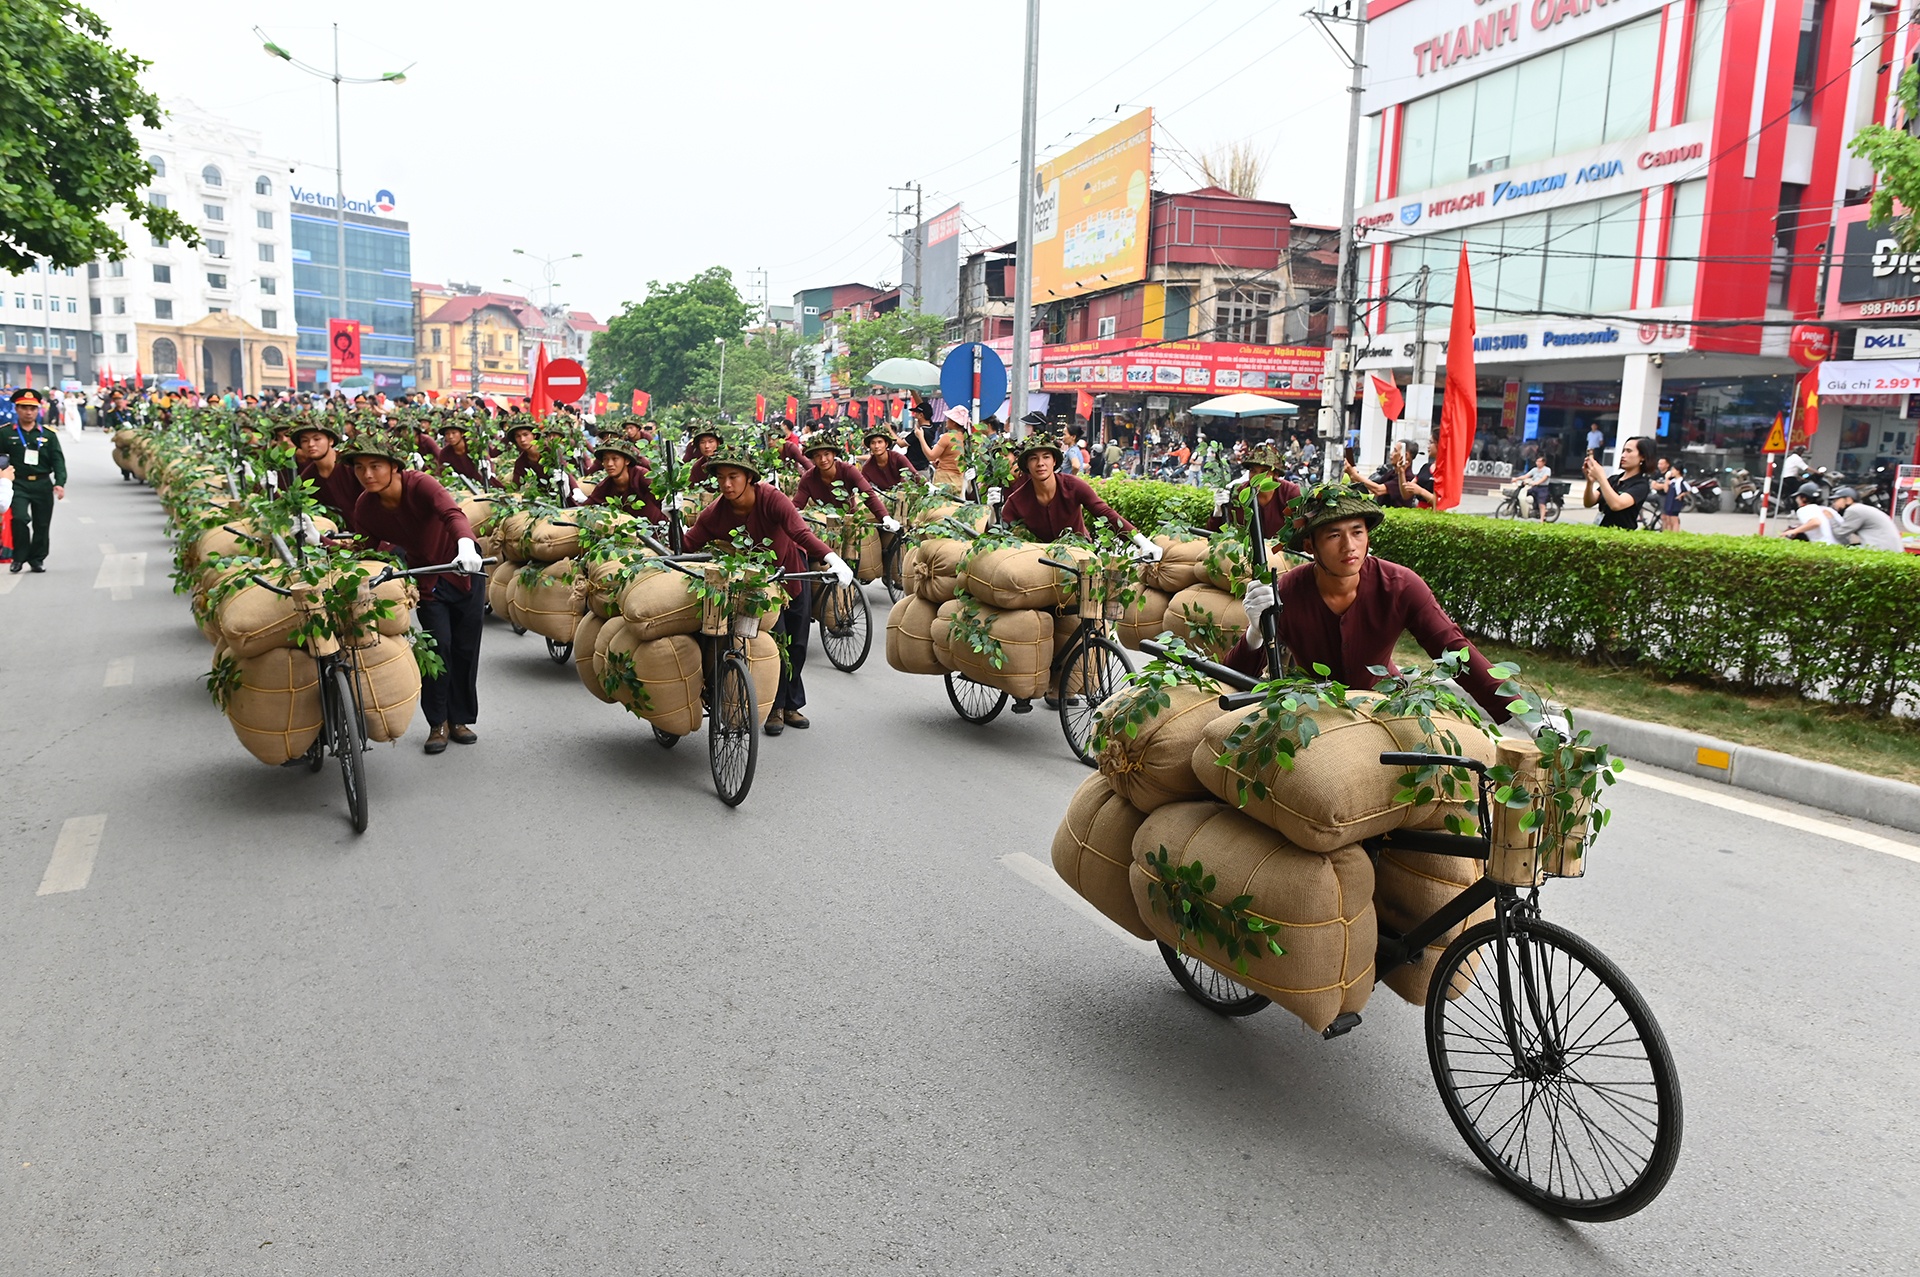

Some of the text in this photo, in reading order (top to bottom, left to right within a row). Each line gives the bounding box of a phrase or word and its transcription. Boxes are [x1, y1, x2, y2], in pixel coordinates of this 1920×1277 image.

[1414, 3, 1519, 77] THANH
[1637, 142, 1703, 170] Canon
[1575, 159, 1624, 185] AQUA
[1506, 173, 1567, 201] DAIKIN
[1428, 192, 1485, 217] HITACHI
[1860, 303, 1880, 315] 898
[1883, 299, 1906, 313] Phố
[1907, 301, 1915, 312] 6
[1474, 334, 1528, 352] AMSUNG
[1542, 327, 1619, 347] Panasonic
[1865, 335, 1905, 348] DELL
[1274, 347, 1295, 357] Ngân
[1297, 348, 1322, 358] Dương
[1827, 380, 1847, 390] Giá
[1851, 380, 1871, 390] chỉ
[1875, 379, 1909, 389] 2.99
